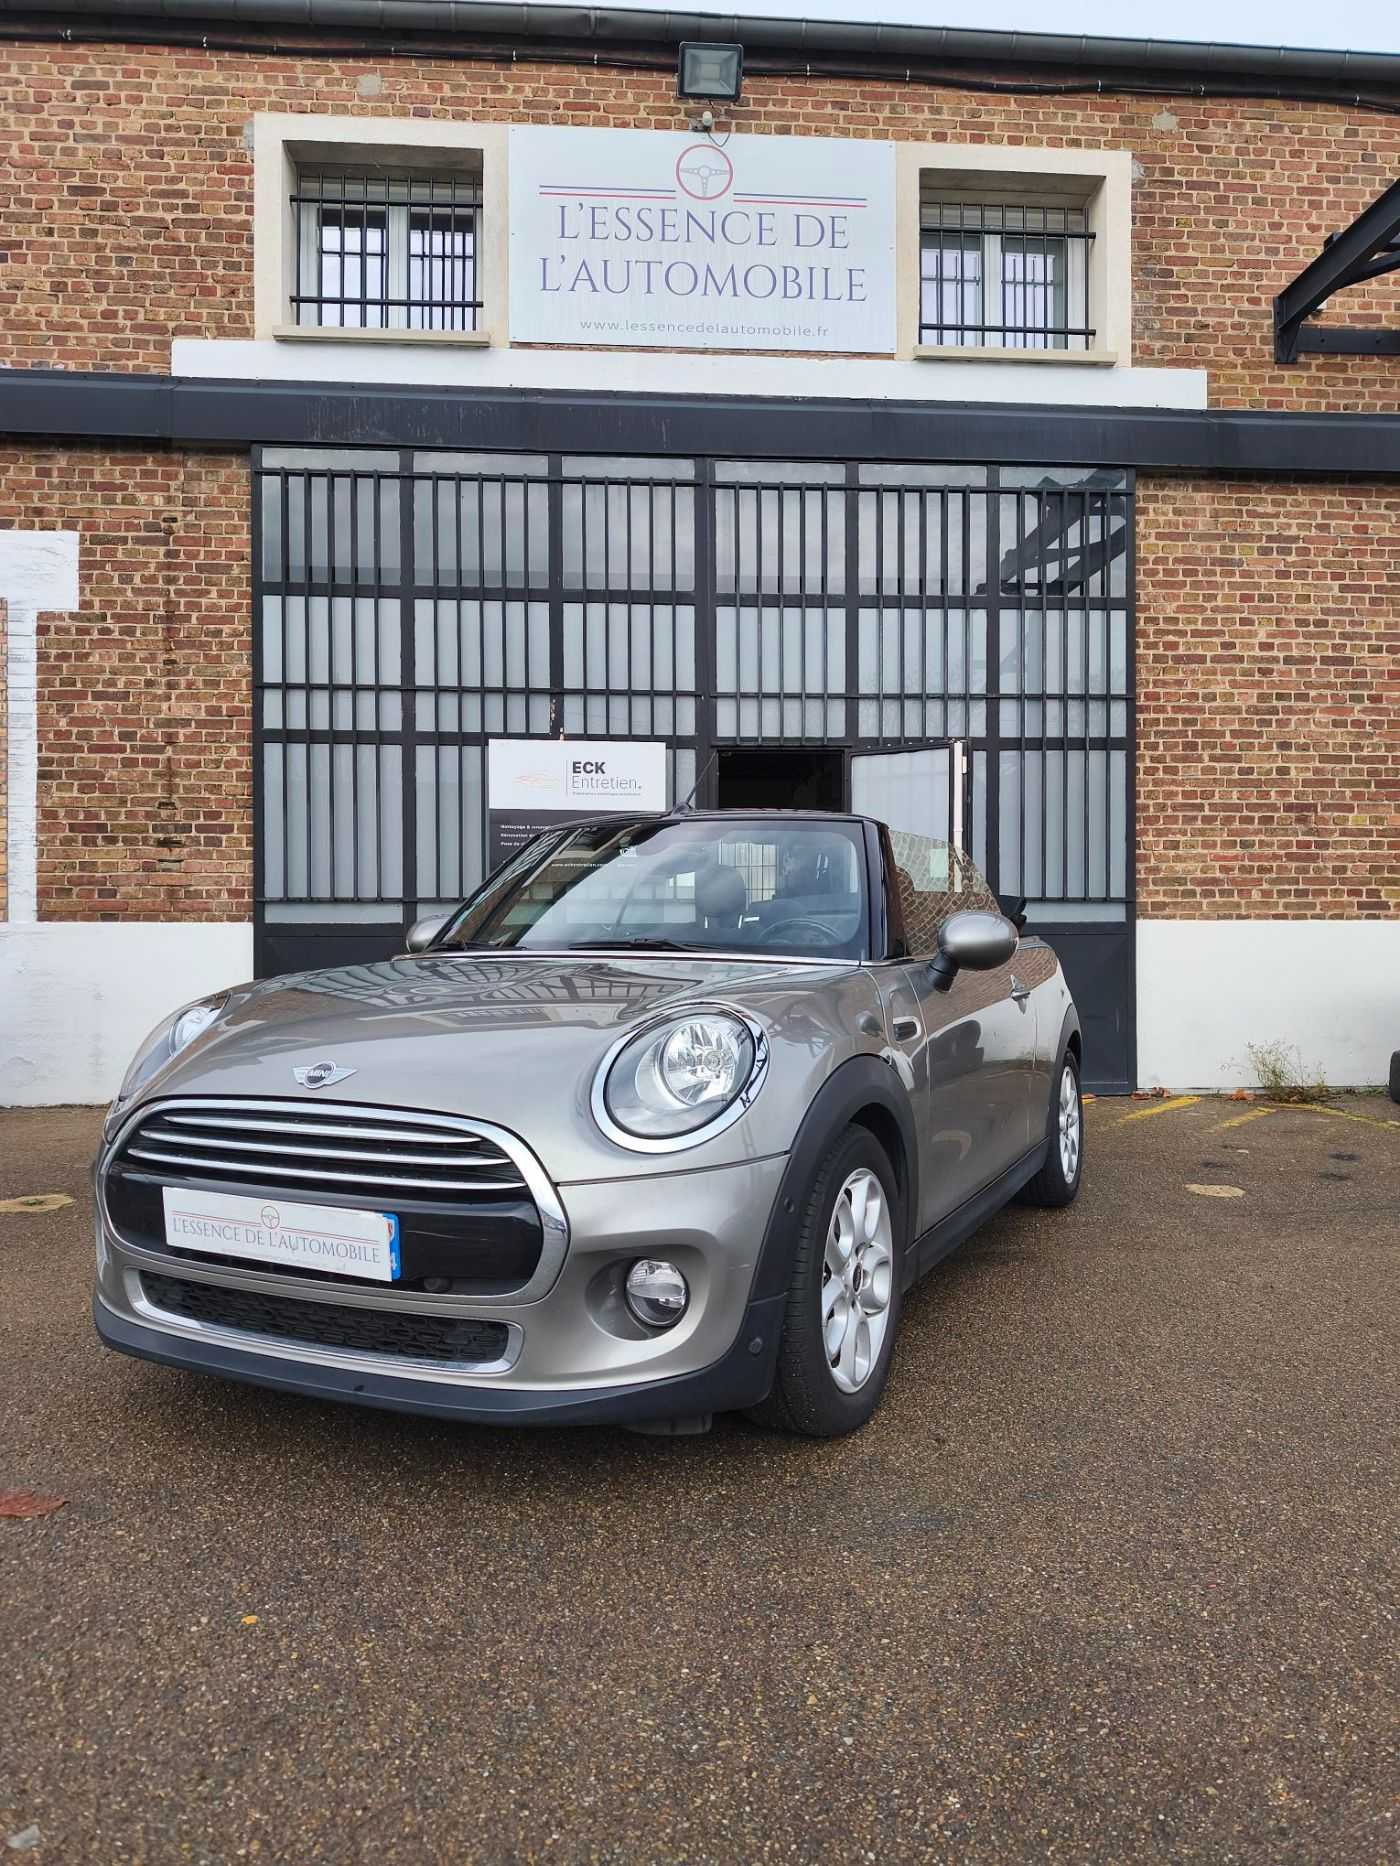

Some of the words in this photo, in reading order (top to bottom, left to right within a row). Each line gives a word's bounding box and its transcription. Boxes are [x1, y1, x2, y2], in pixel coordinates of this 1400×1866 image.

[558, 202, 777, 246] L'ESSENCE
[793, 213, 849, 249] DE
[538, 254, 867, 302] L'AUTOMOBILE
[579, 318, 830, 337] www.lessencedelautomobile.fr
[571, 775, 643, 790] Entretien.
[572, 761, 606, 774] ECK
[172, 1216, 241, 1242] L'ESSENCE
[245, 1228, 266, 1246] DE
[269, 1230, 381, 1264] L'AUTOMOBILE
